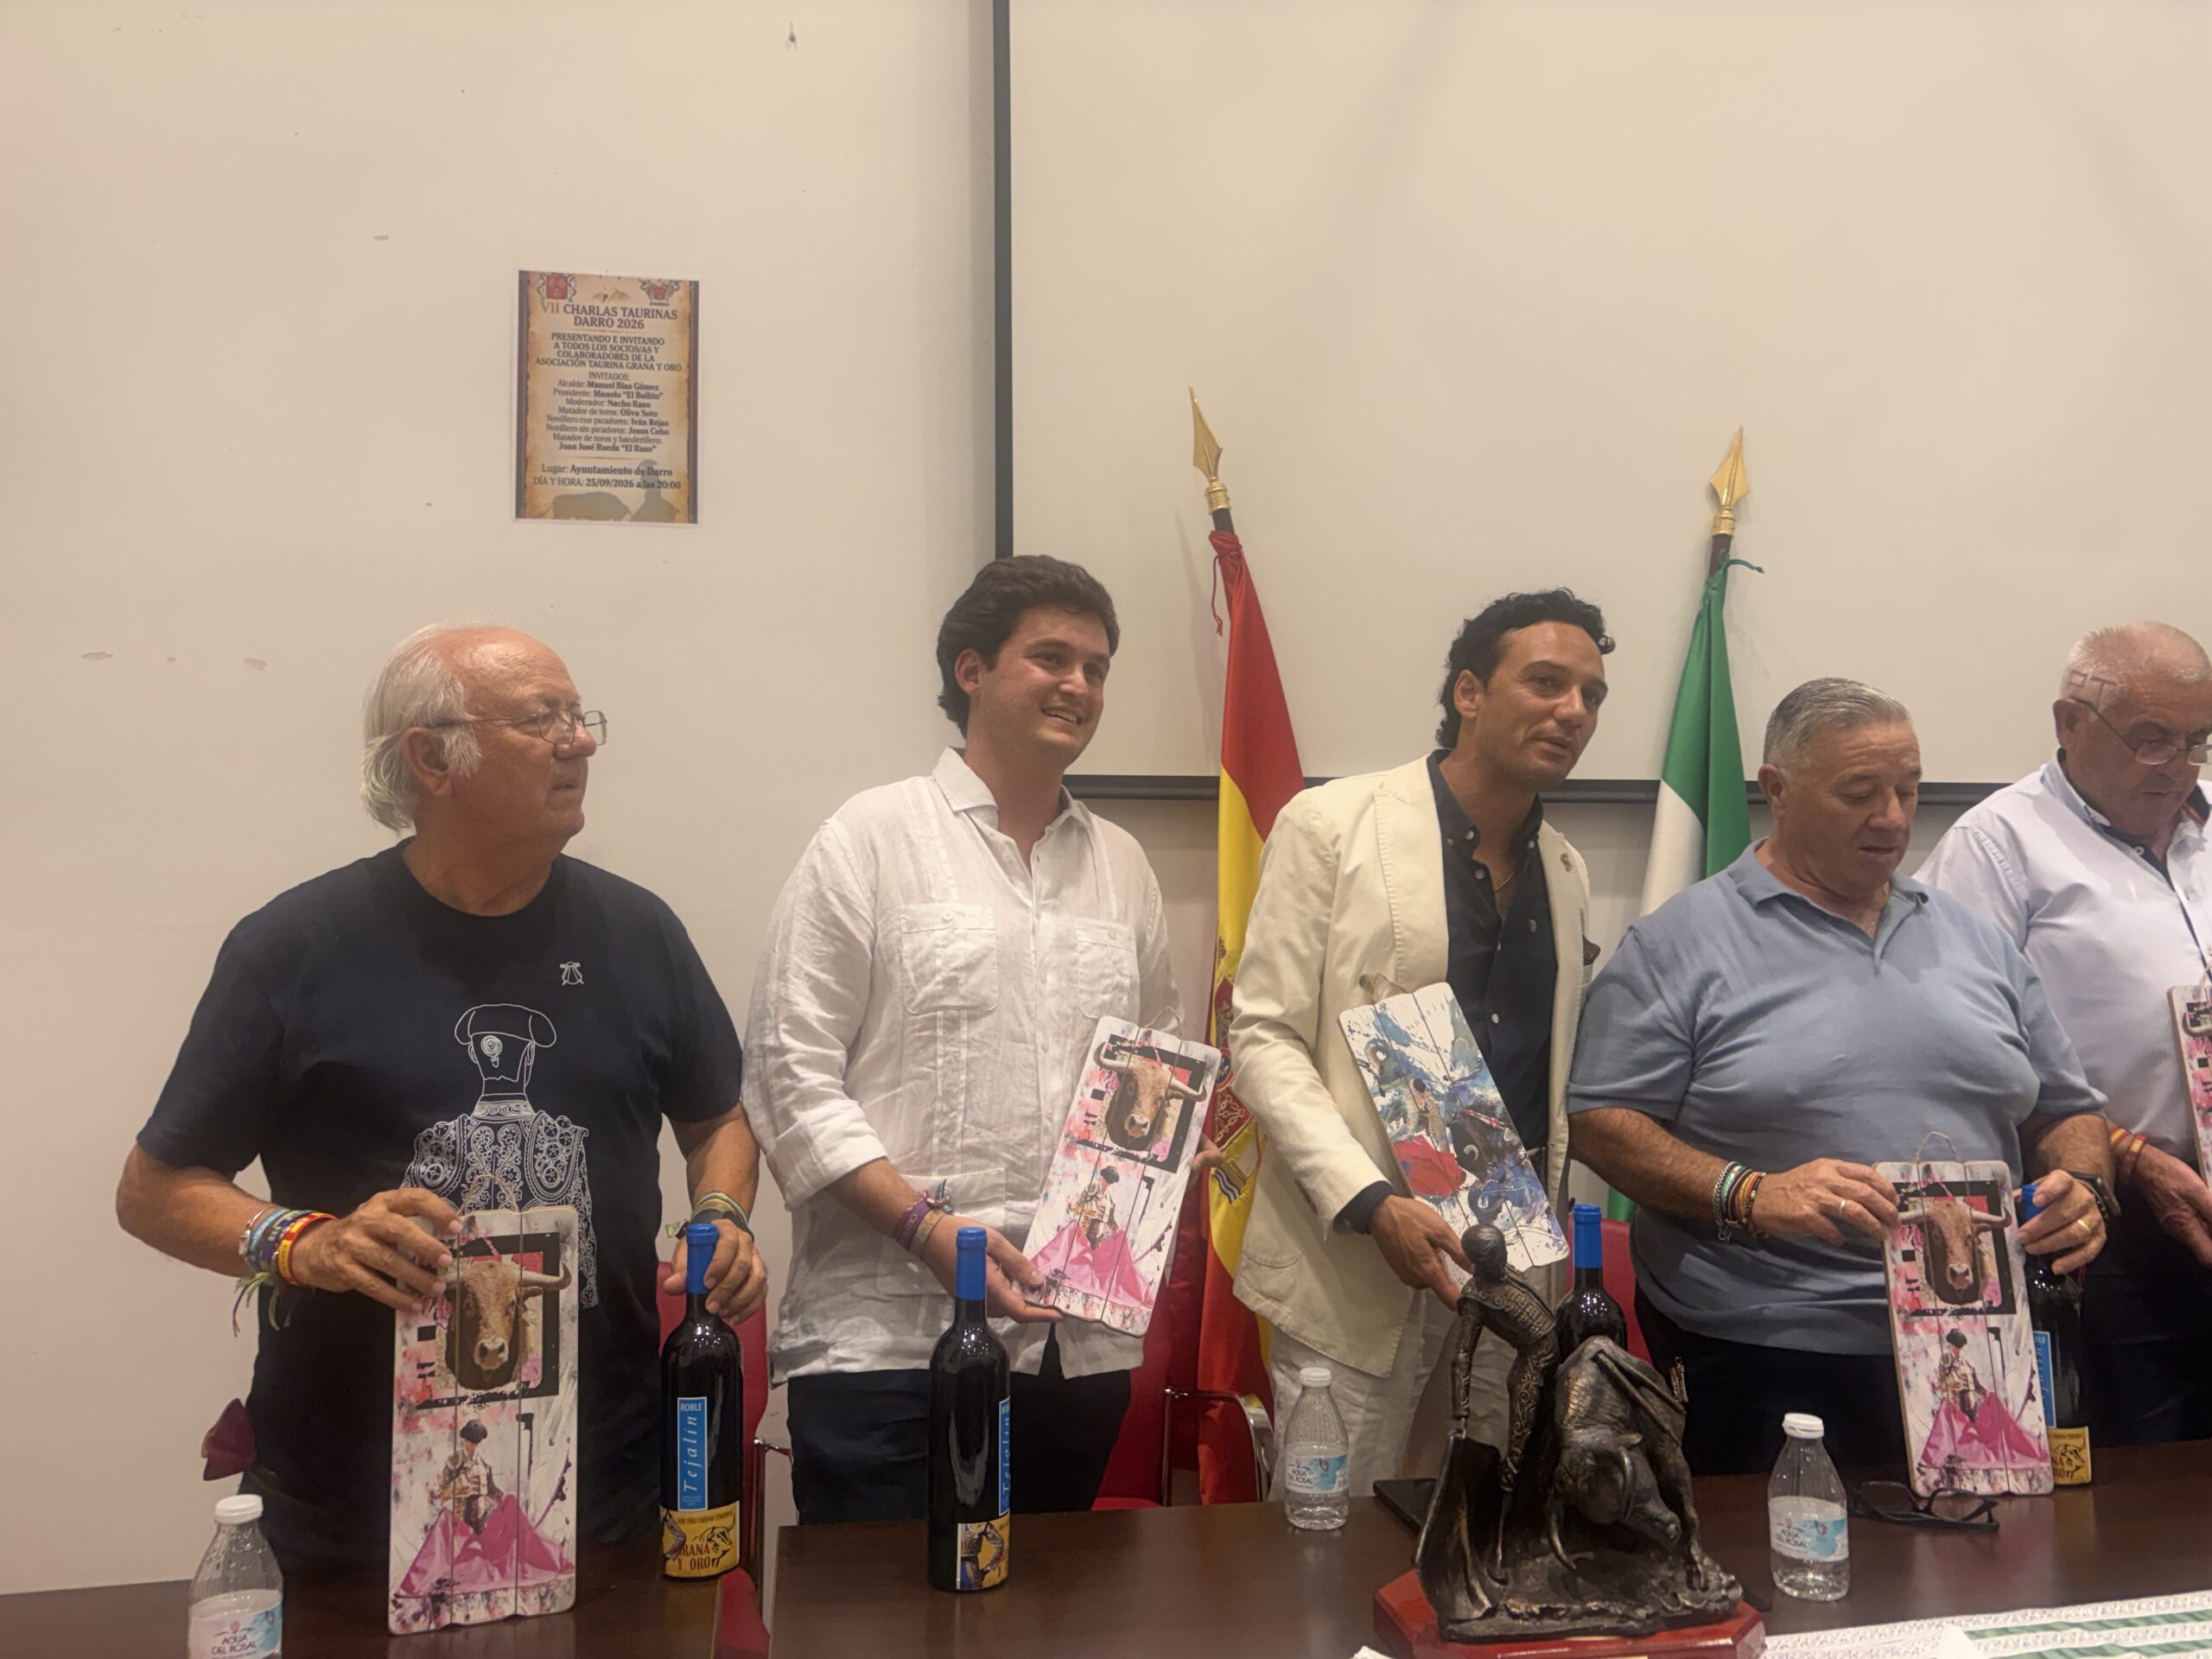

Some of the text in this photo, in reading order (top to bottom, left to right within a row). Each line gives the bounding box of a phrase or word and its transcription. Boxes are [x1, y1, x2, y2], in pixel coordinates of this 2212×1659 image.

[541, 302, 677, 320] VII CHARLAS TAURINAS
[574, 315, 645, 329] DARRO 2026
[551, 332, 664, 346] PRESENTANDO E INVITANDO
[562, 341, 590, 351] TODOS
[591, 342, 607, 351] LOS
[609, 344, 652, 353] SOCIOS/AS
[654, 346, 660, 354] Y
[556, 350, 630, 361] COLABORADORES
[535, 357, 586, 367] ASOCIACIÓN
[588, 359, 624, 369] TAURINA
[626, 362, 655, 371] GRANA
[664, 363, 682, 372] ORO
[588, 372, 630, 380] INVITADOS:
[557, 378, 659, 391] Alcalde: Manuel Blas Gómez
[553, 387, 592, 397] Presidente:
[593, 389, 621, 398] Manolo
[565, 397, 651, 409] Moderador: Nacho Raso
[557, 405, 588, 415] Matador
[588, 407, 598, 416] de
[620, 408, 639, 416] Oliva
[641, 409, 658, 417] Soto
[546, 414, 578, 423] Novillero
[631, 417, 647, 426] Iván
[649, 418, 669, 428] Rejas
[545, 423, 578, 432] Novillero
[650, 427, 670, 435] Cobo
[553, 432, 582, 442] Matador
[558, 442, 577, 450] Juan
[541, 463, 673, 476] Lugar: Ayuntamiento de Darro
[533, 475, 548, 486] DÍA
[550, 477, 556, 486] Y
[557, 477, 584, 486] HORA:
[586, 477, 634, 488] 25/09/2026
[643, 480, 655, 488] las
[657, 480, 682, 489] 20:00
[680, 1402, 702, 1412] ROBLE
[677, 1555, 710, 1570] Y ORO
[211, 1645, 227, 1655] DEL
[230, 1641, 257, 1652] ROSAL
